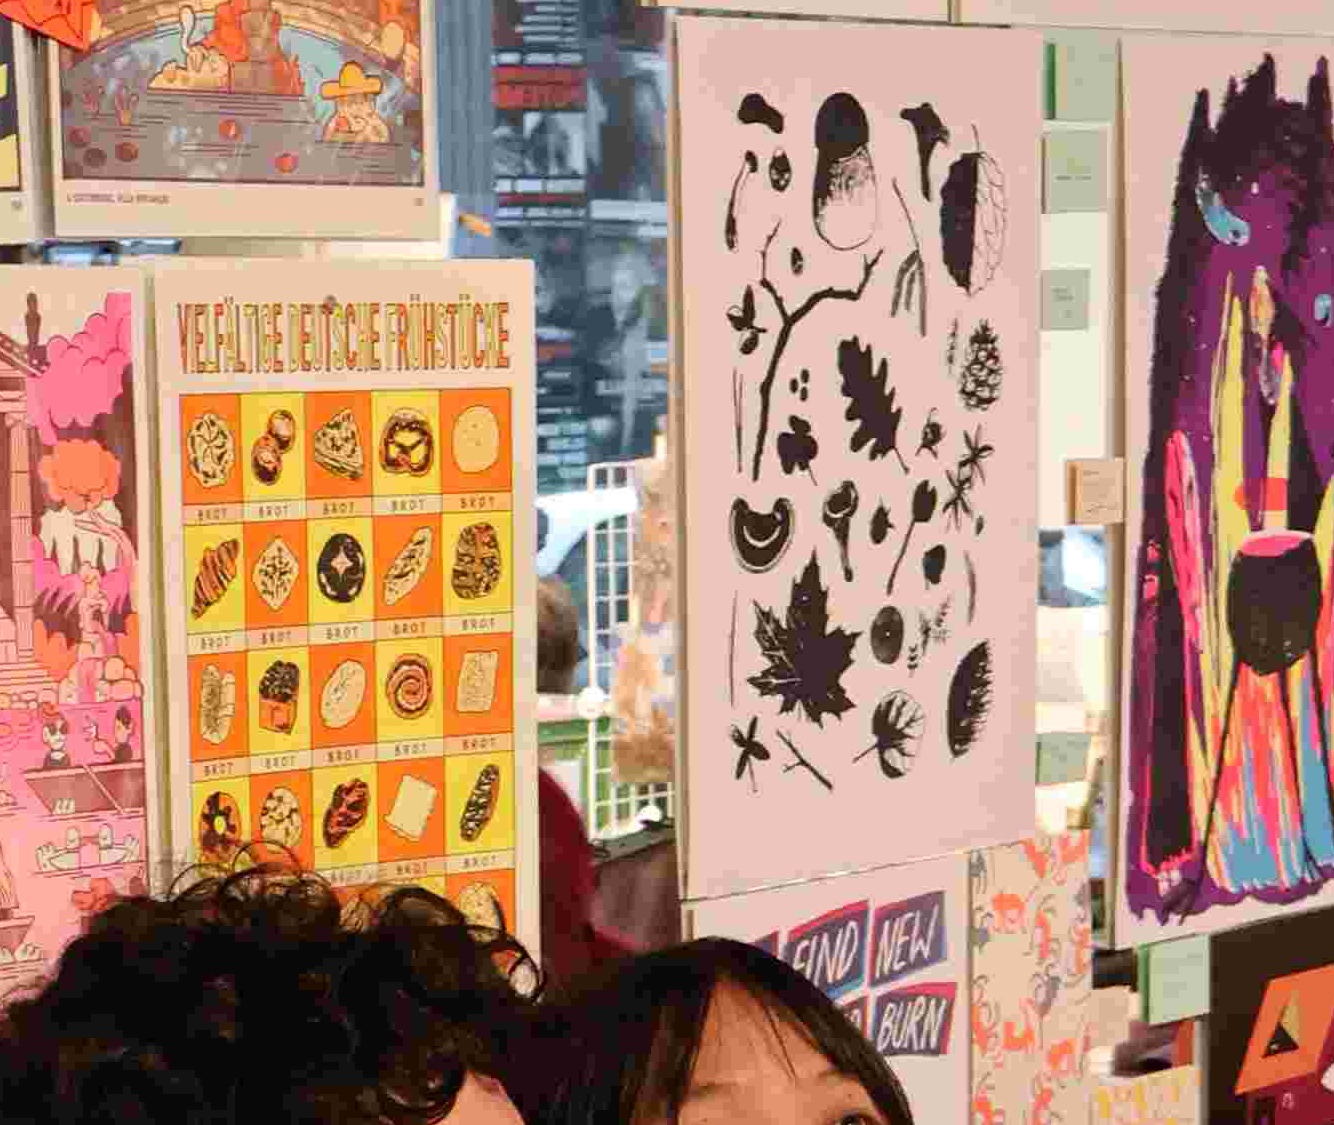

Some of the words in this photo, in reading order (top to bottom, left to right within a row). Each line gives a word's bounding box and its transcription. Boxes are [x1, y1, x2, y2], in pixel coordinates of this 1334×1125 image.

[176, 295, 283, 374] VIELFÄLTIGE
[287, 300, 380, 373] DEUTSCHE
[384, 293, 510, 371] FRÜHSTÜCKE
[322, 502, 355, 515] BROT
[391, 499, 426, 512] BROT
[460, 495, 496, 509] BROT
[198, 508, 228, 521] BROT
[259, 506, 289, 518] BROT
[393, 622, 426, 635] BROT
[462, 618, 496, 631] BROT
[261, 631, 291, 645] BROT
[326, 627, 359, 640] BROT
[201, 636, 230, 650] BROT
[462, 737, 497, 750] BROT
[791, 920, 860, 985] FIND
[876, 904, 939, 977] NEW
[877, 996, 947, 1052] BURN
